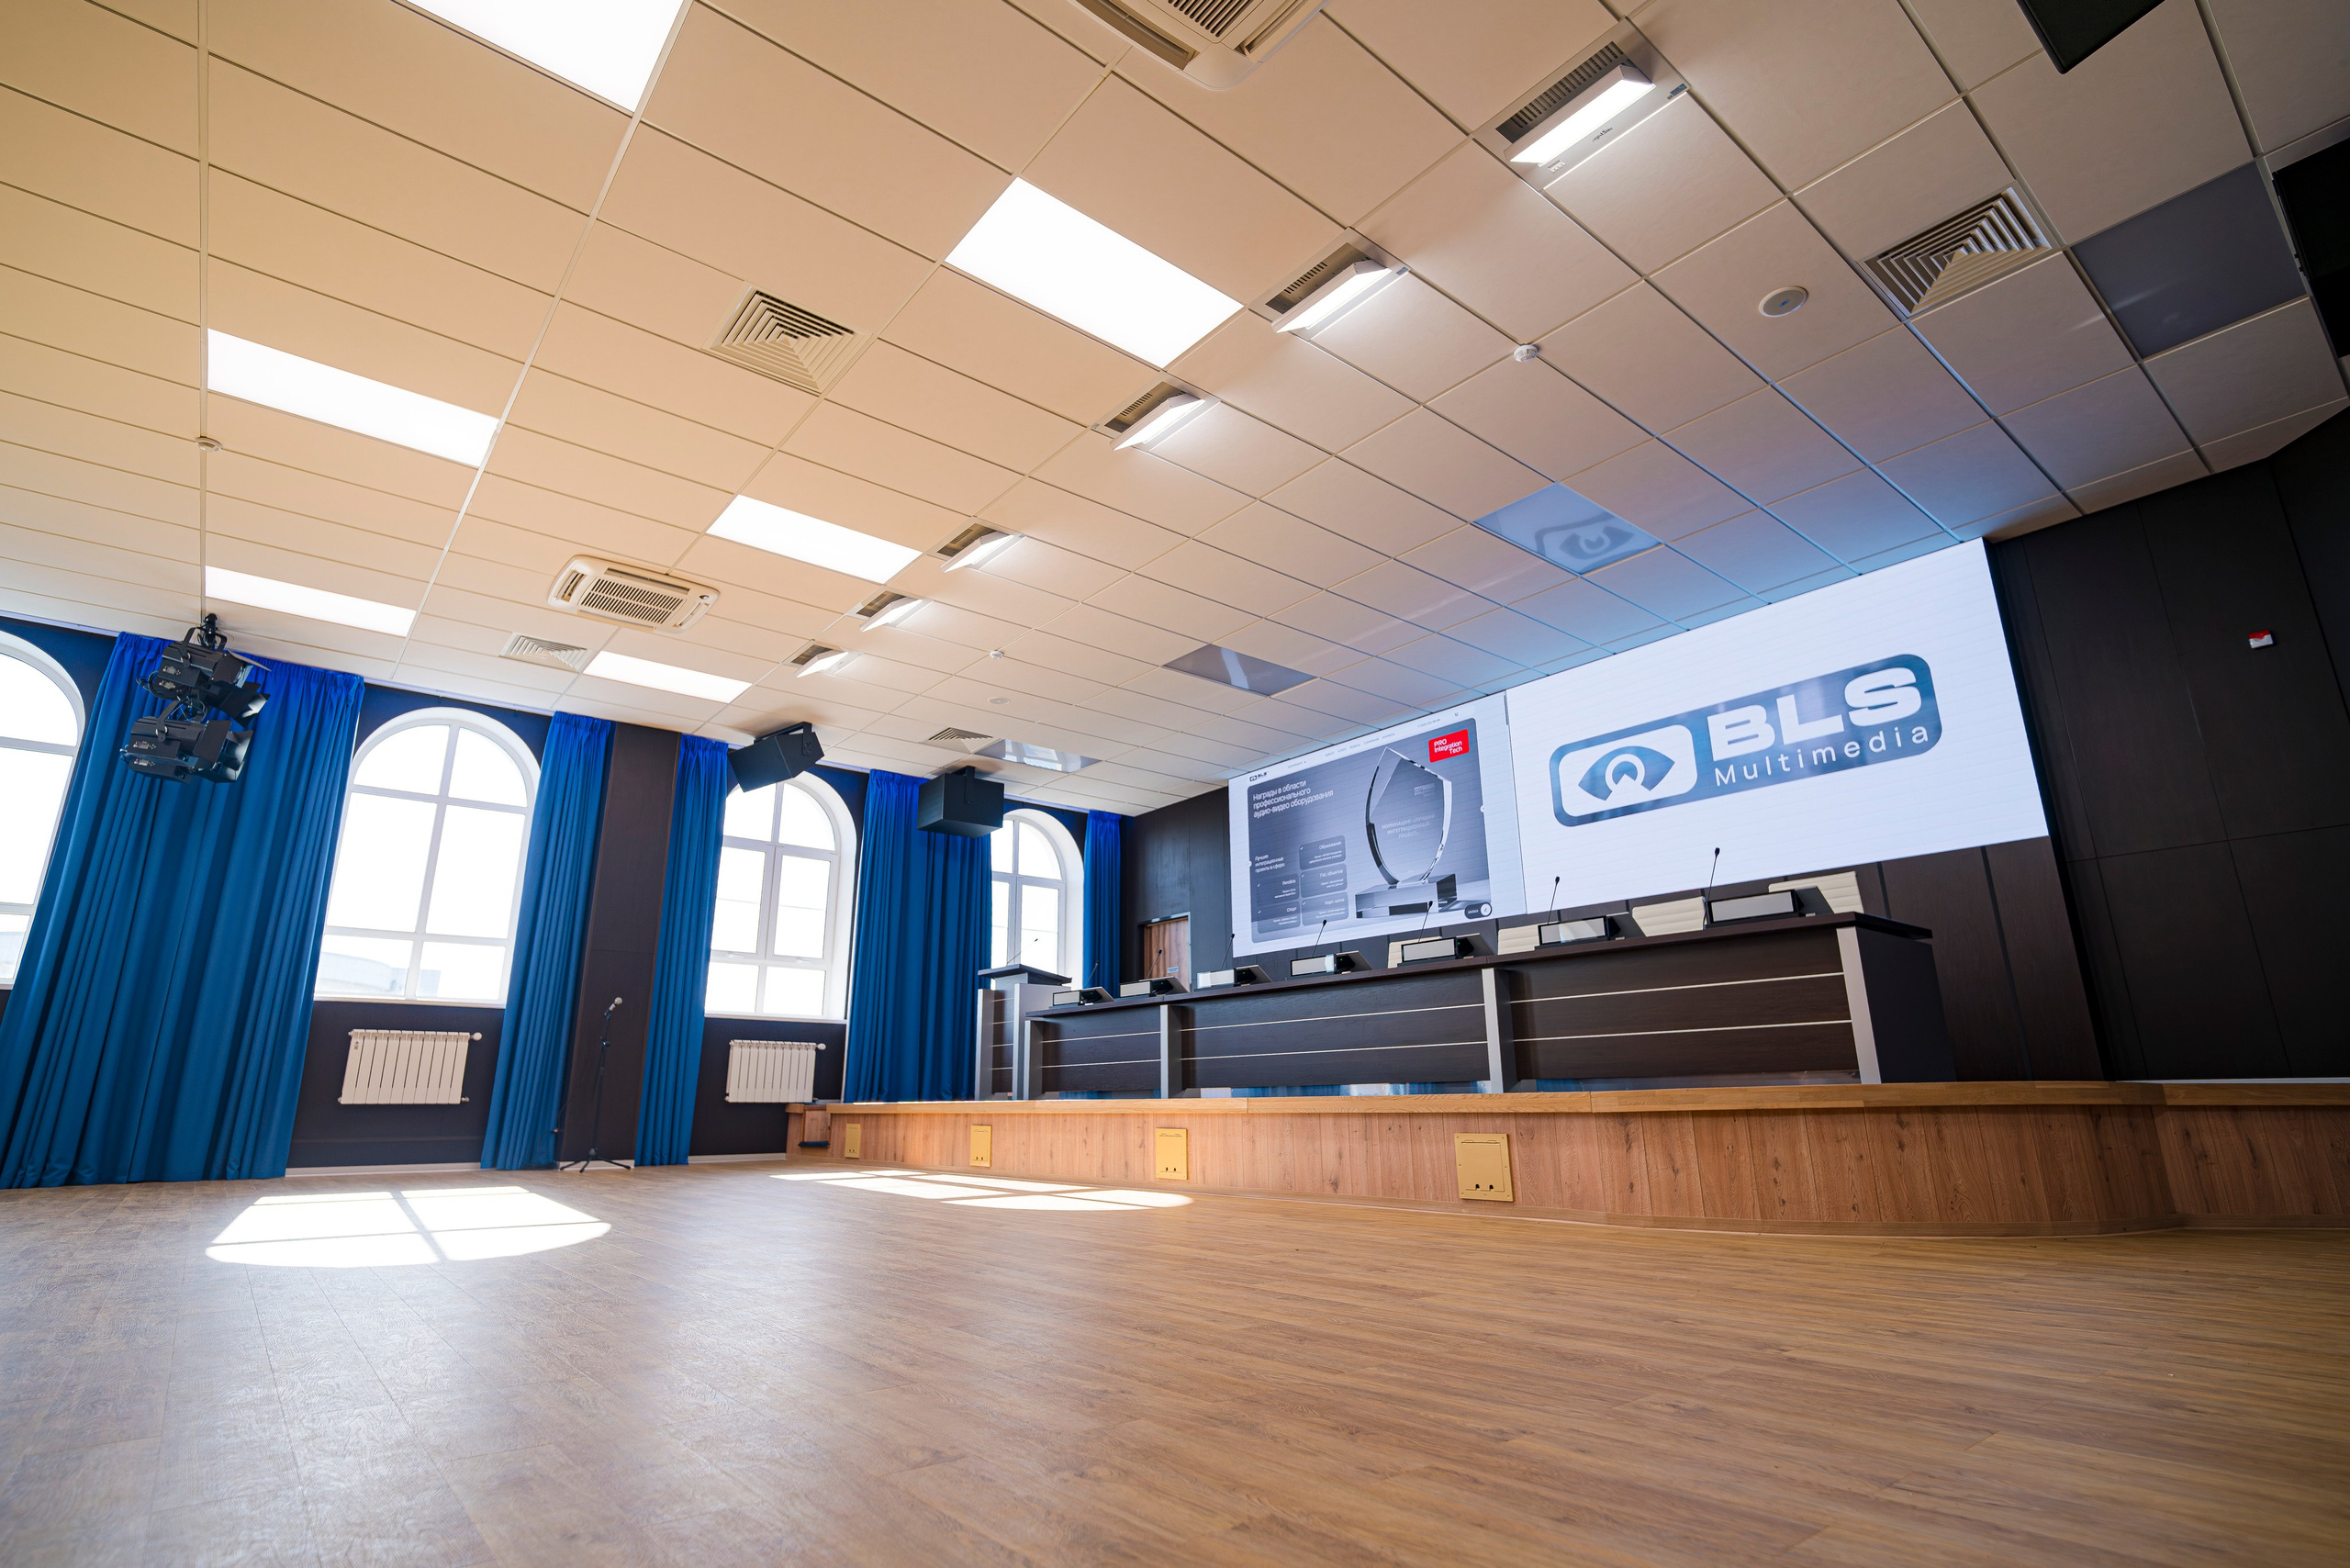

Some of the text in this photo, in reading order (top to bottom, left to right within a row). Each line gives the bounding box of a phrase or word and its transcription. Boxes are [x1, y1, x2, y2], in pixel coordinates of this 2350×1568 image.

[1707, 666, 1922, 762] BLS
[1434, 738, 1448, 746] PRO
[1434, 740, 1462, 753] Integration
[1449, 746, 1462, 755] Tech
[1714, 724, 1929, 787] Multimedia
[1253, 789, 1277, 801] Награды
[1282, 780, 1306, 793] области
[1253, 788, 1311, 810] профессионального
[1253, 790, 1334, 819] аудио-видео оборудования
